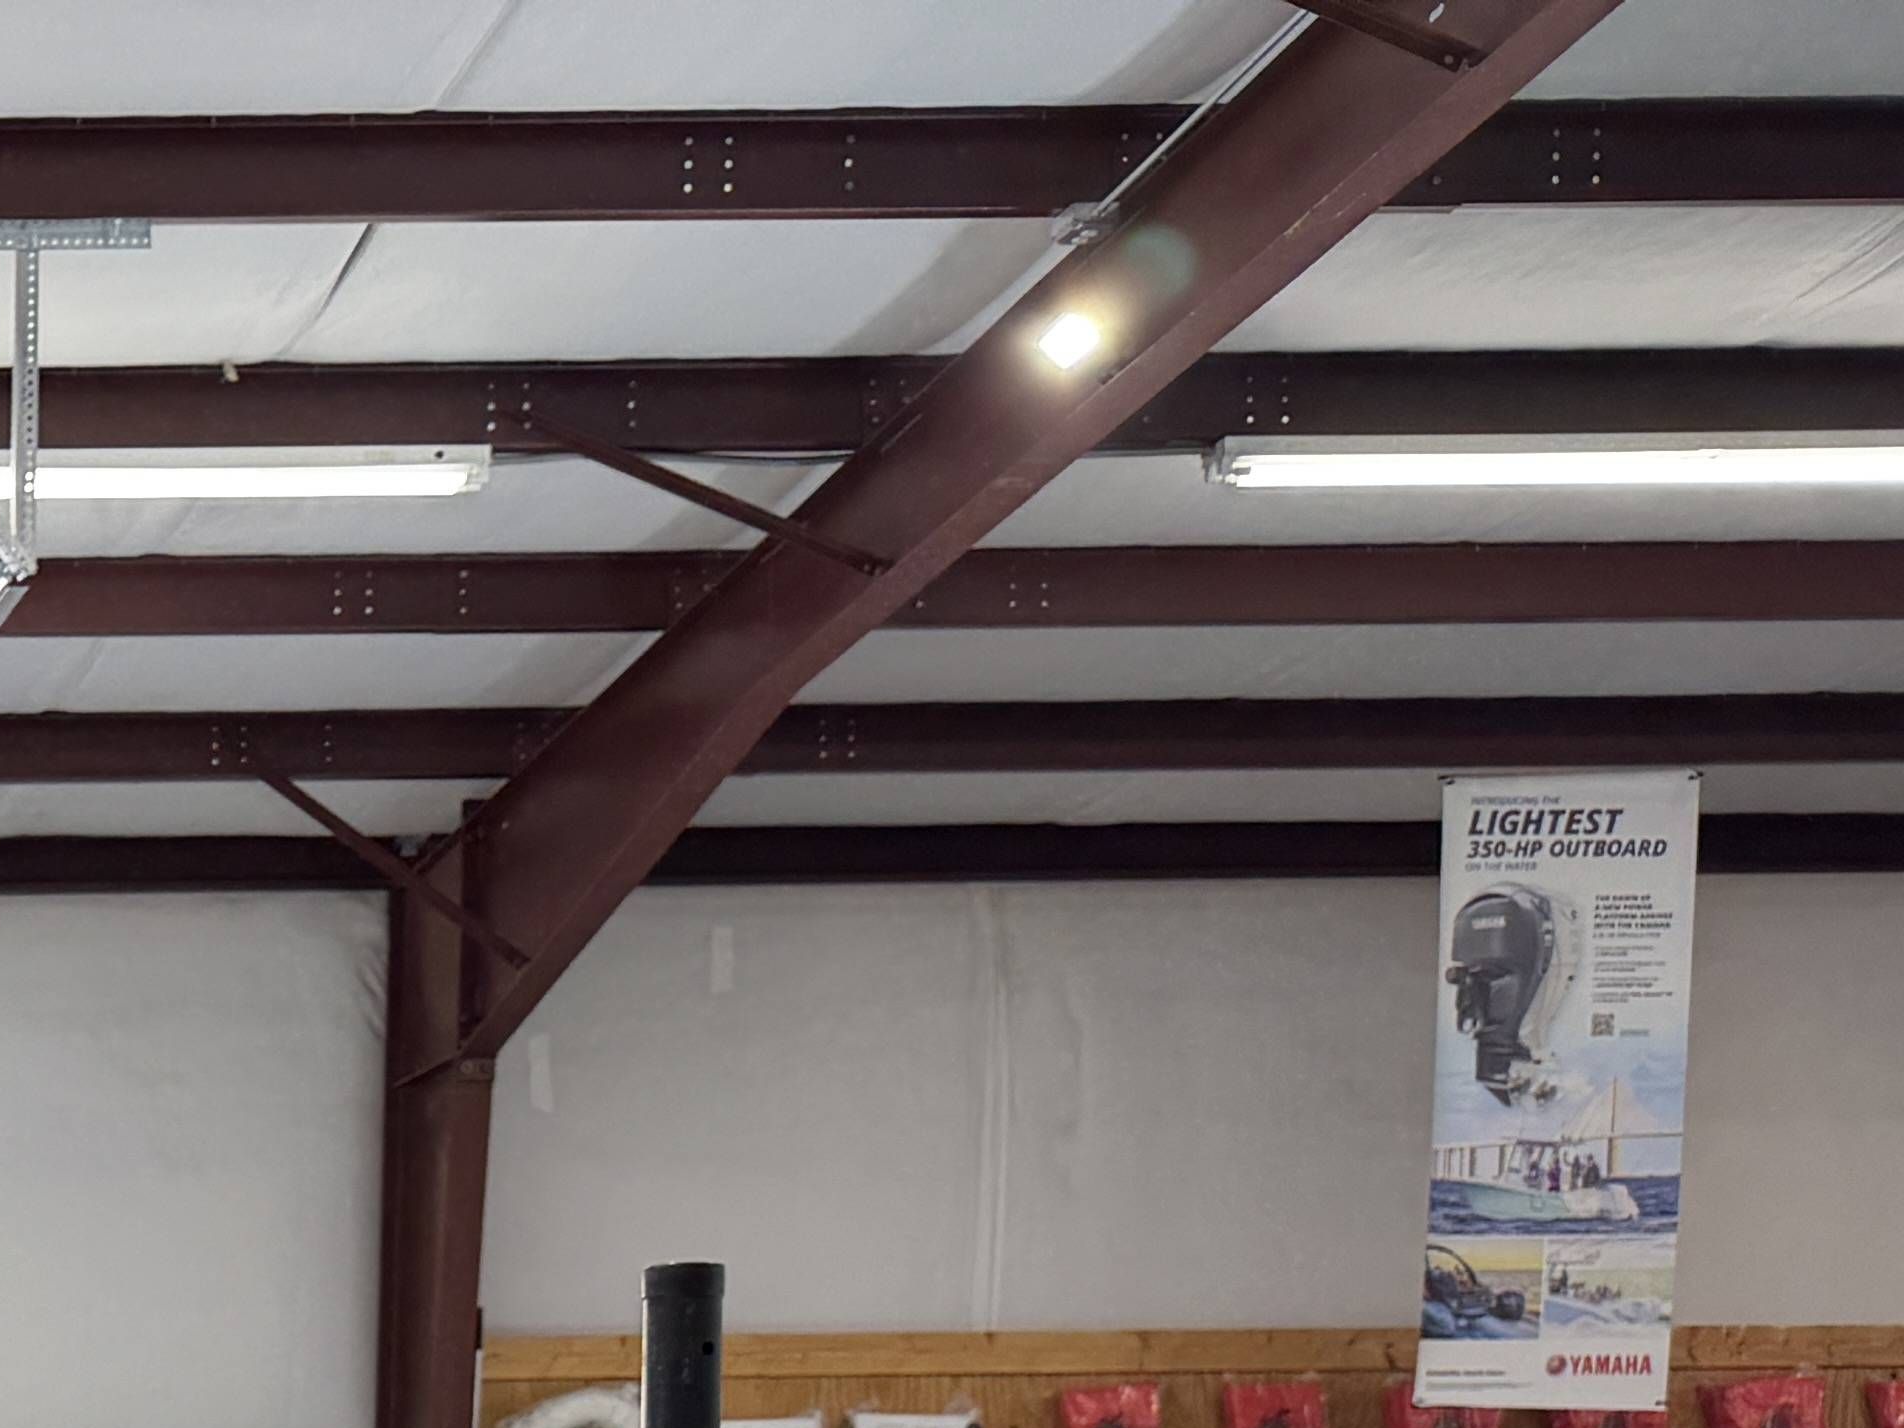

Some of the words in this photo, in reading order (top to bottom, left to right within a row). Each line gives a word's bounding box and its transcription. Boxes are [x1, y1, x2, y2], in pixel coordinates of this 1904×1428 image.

[1468, 808, 1624, 836] LIGHTEST
[1467, 840, 1543, 859] 350-HP
[1549, 838, 1668, 858] OUTBOARD
[1465, 862, 1481, 872] ON
[1483, 862, 1501, 872] THE
[1504, 861, 1538, 872] WATER
[1570, 1354, 1652, 1375] YAMAHA
